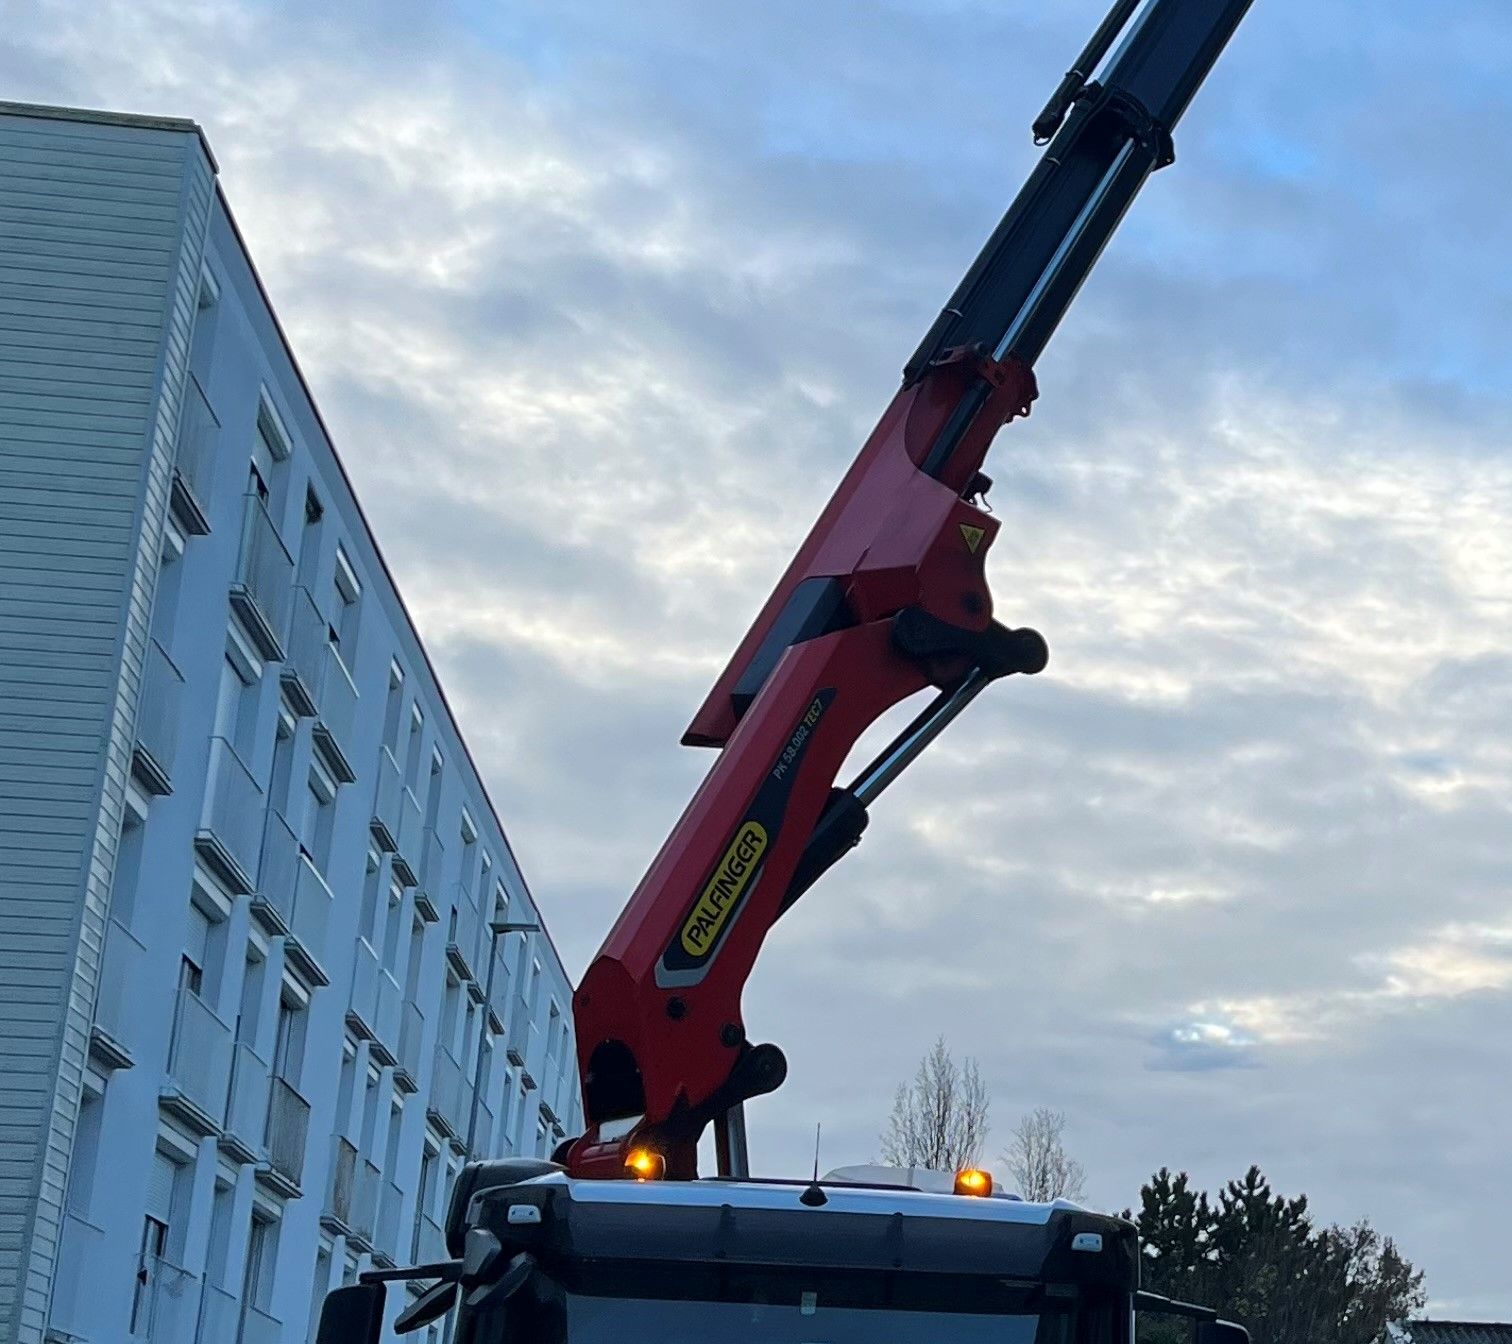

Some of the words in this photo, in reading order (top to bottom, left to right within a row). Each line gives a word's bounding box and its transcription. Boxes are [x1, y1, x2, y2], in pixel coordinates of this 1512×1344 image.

[772, 761, 788, 780] PK
[803, 698, 823, 728] TEC7
[687, 829, 763, 947] PALFINGER
